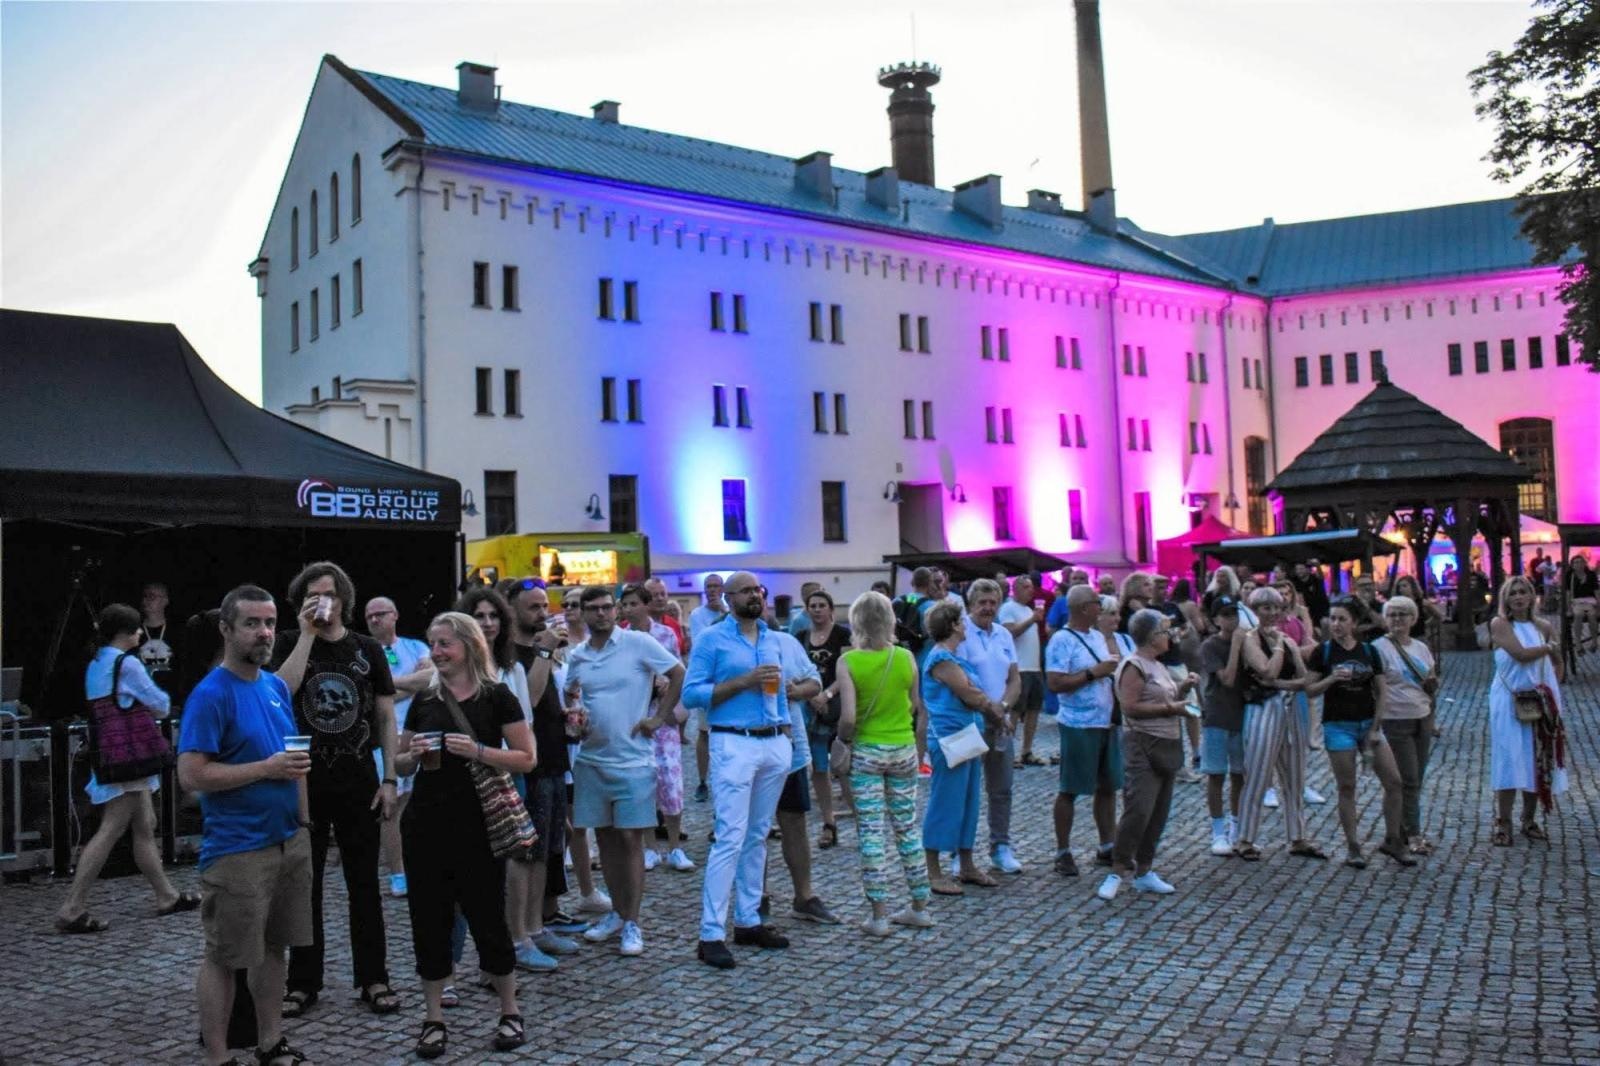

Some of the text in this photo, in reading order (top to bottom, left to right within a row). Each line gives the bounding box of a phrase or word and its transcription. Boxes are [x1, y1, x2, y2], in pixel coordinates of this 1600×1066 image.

[311, 491, 361, 518] BB
[362, 494, 439, 509] GROUP
[363, 508, 439, 521] AGENCY
